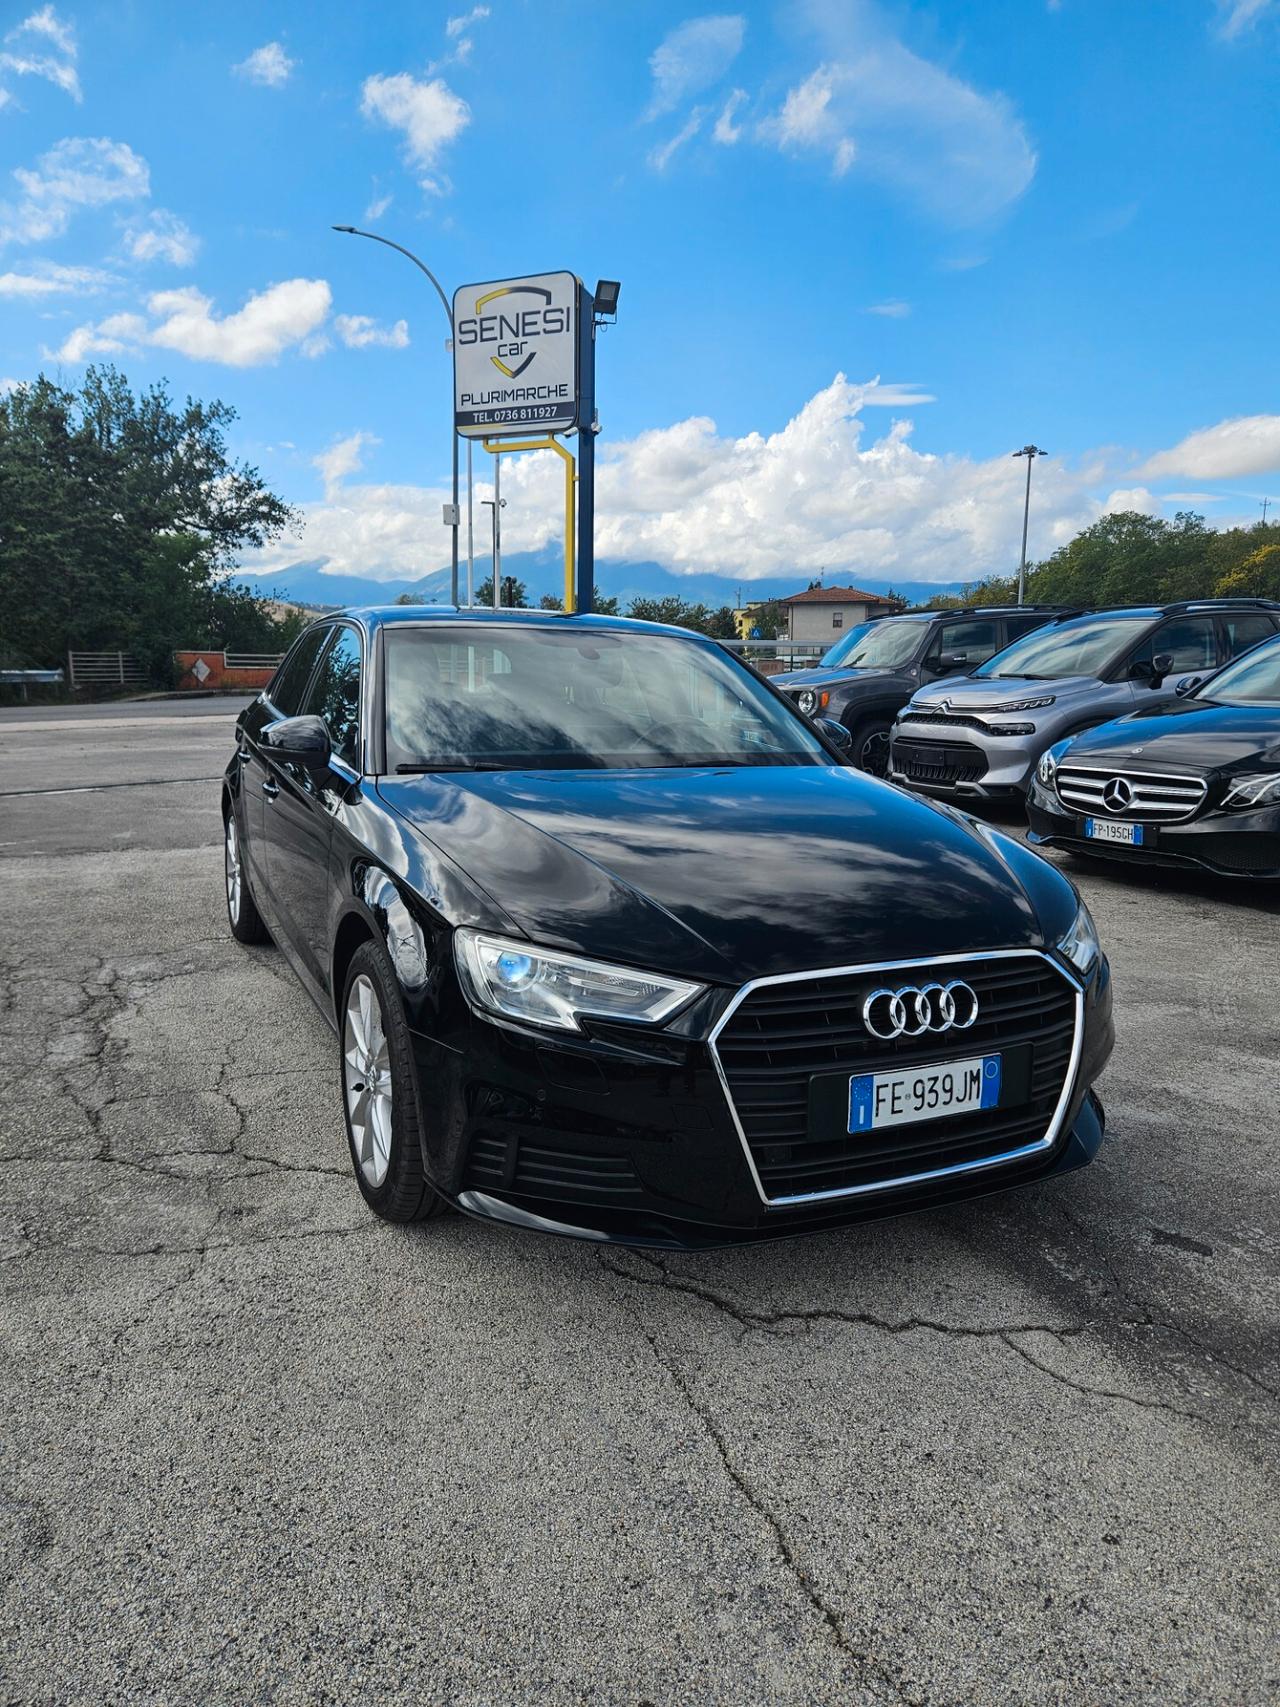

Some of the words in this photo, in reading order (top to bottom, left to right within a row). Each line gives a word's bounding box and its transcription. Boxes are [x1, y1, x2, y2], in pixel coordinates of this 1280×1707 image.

[458, 306, 570, 345] SENESI
[497, 341, 528, 357] car
[461, 384, 568, 406] PLURIMARCHE
[473, 412, 493, 423] TEL.
[494, 411, 518, 421] 0736
[520, 406, 557, 418] 811927
